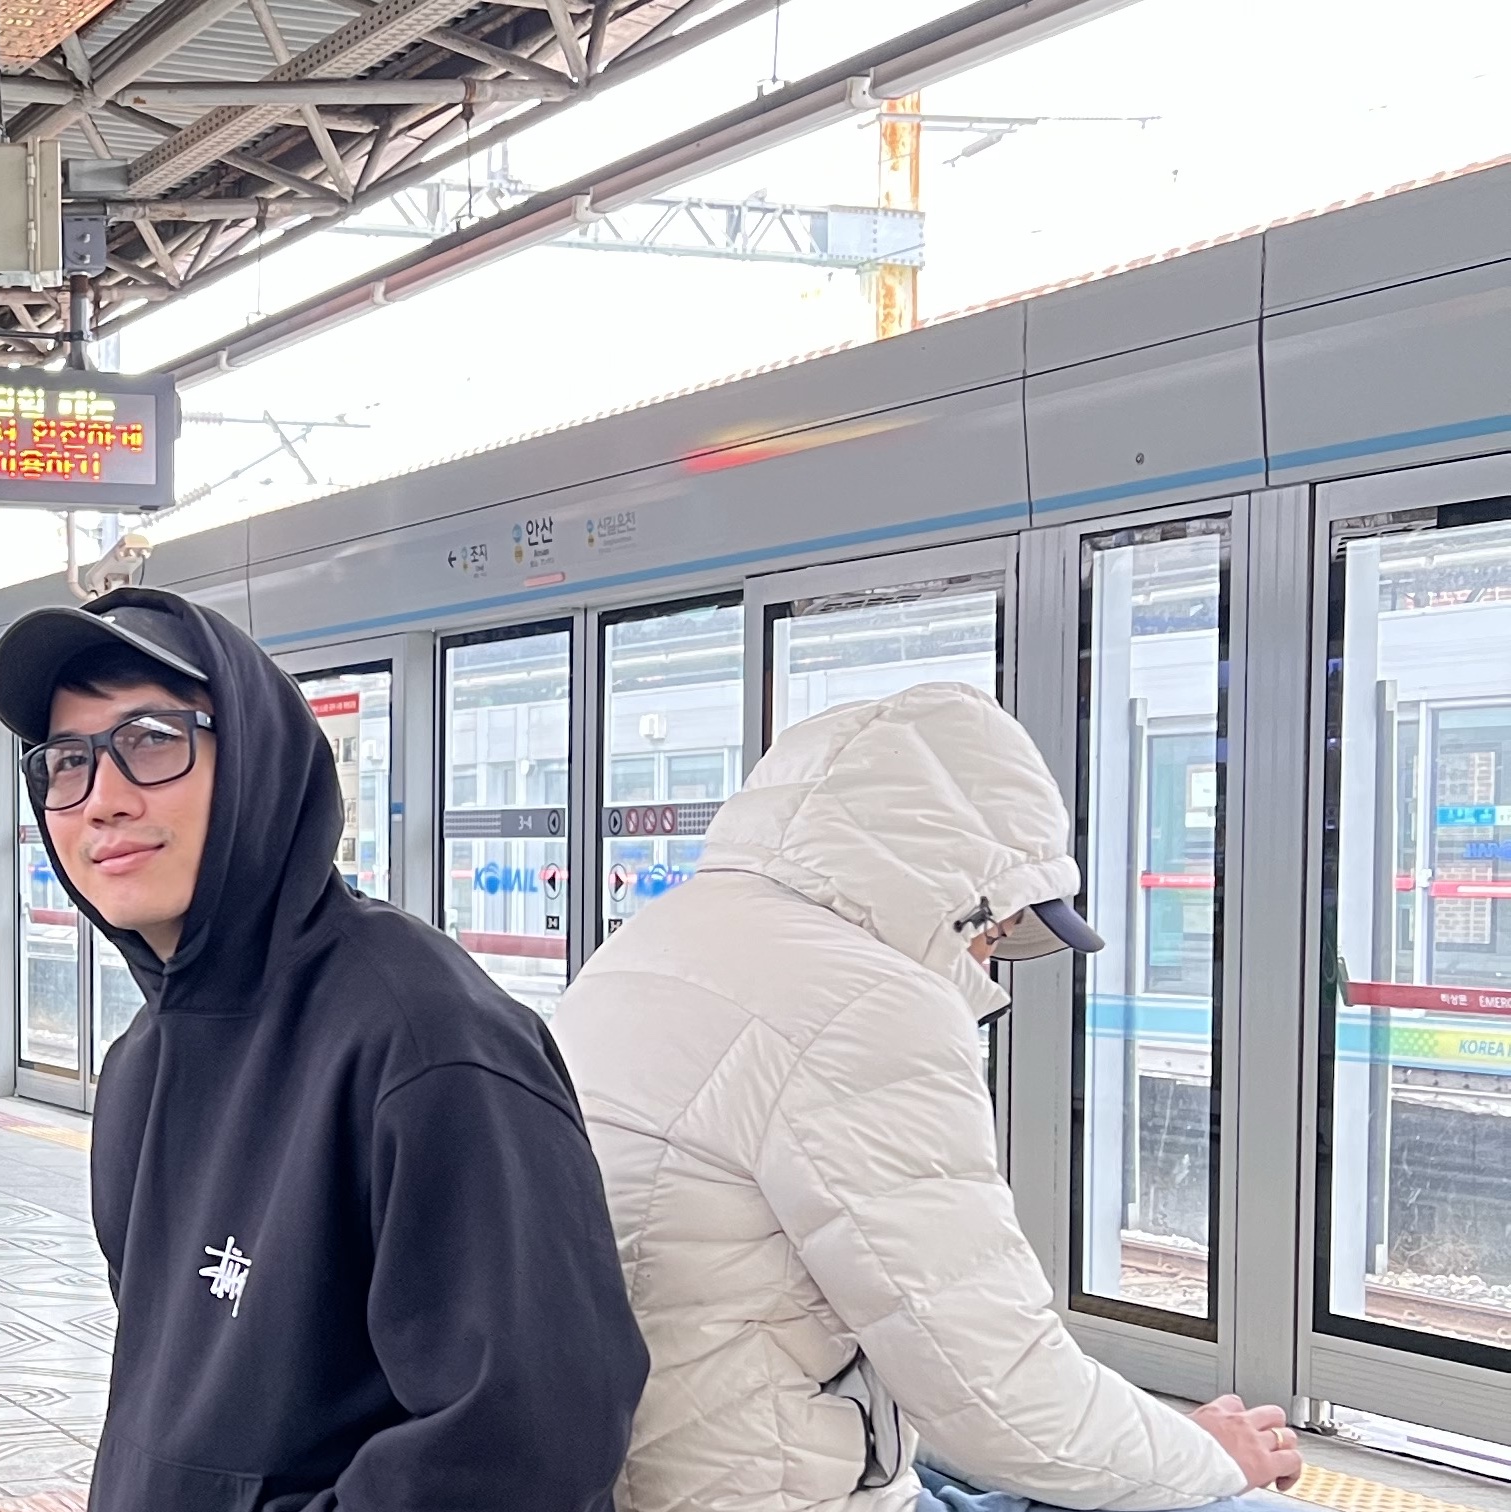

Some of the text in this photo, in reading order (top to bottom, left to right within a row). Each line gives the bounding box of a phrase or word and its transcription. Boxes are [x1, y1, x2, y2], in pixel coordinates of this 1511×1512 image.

[526, 516, 553, 546] 안산
[518, 815, 533, 830] 3-4
[1440, 993, 1469, 1006] 비상문
[1459, 1040, 1505, 1057] KOREA
